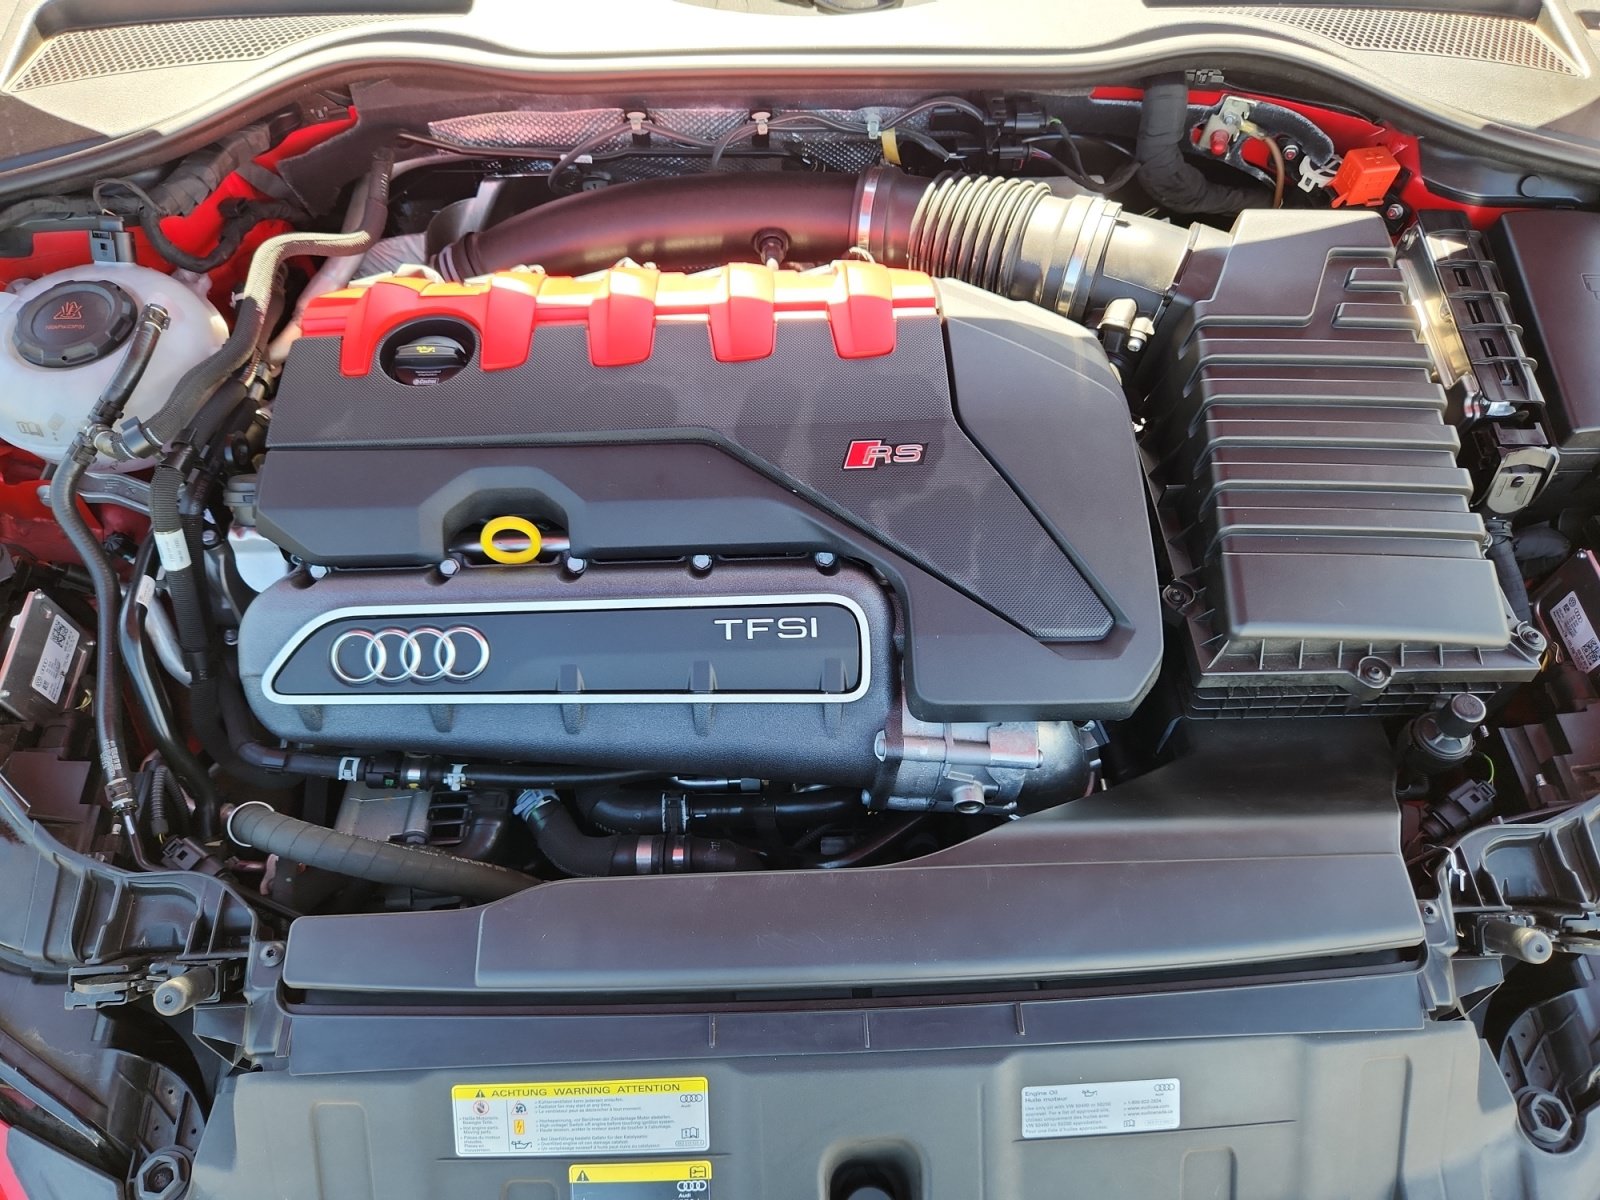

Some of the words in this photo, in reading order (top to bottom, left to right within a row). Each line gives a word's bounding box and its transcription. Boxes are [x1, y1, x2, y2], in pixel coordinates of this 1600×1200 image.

[713, 617, 818, 640] TFSI
[491, 1088, 547, 1097] ACHTUNG
[554, 1086, 610, 1095] WARNING
[617, 1083, 680, 1093] ATTENTION
